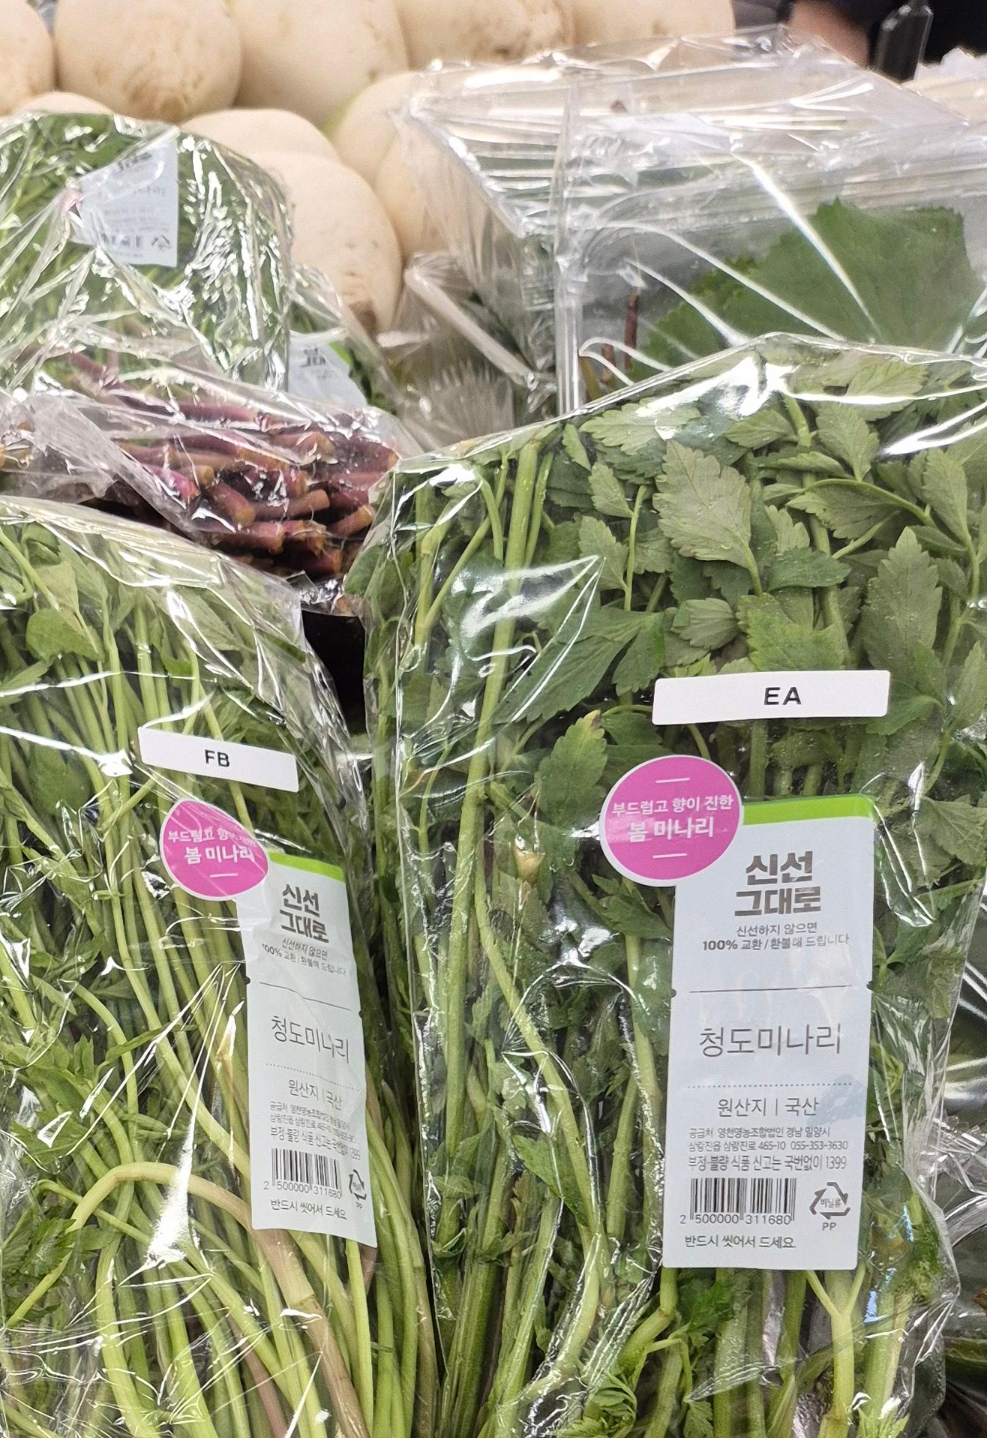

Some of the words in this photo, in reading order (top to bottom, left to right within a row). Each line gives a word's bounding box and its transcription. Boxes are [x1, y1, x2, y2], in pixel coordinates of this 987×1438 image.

[764, 687, 801, 705] EA
[204, 749, 231, 768] FB
[611, 799, 669, 817] 부드럽고
[672, 797, 700, 812] 향이
[704, 795, 733, 811] 진한
[628, 821, 648, 842] 봄
[653, 817, 714, 840] 미나리
[184, 847, 202, 865] 봄
[205, 845, 254, 864] 미나리
[746, 851, 813, 885] 신선
[282, 884, 320, 917] 신선
[734, 886, 821, 916] 그대로
[280, 910, 329, 943] 그대로
[736, 924, 780, 937] 신선하지
[784, 922, 817, 935] 않으면
[282, 938, 309, 954] 신선하지
[703, 939, 738, 951] 100%
[806, 934, 849, 948] 드립니다
[699, 1023, 841, 1057] 청도미나리
[288, 1079, 319, 1102] 원산지
[326, 1090, 342, 1111] 국산
[718, 1097, 766, 1117] 원산지
[785, 1097, 819, 1116] 국산
[786, 1127, 803, 1138] 경남
[758, 1141, 786, 1151] 465-10
[790, 1140, 849, 1150] 055-353-3630
[731, 1155, 750, 1171] 식품
[753, 1156, 782, 1171] 신고는
[784, 1155, 823, 1171] 국번없이
[825, 1156, 847, 1170] 1399
[263, 1181, 270, 1191] 2
[277, 1181, 310, 1194] 500000
[270, 1199, 298, 1212] 반드시
[300, 1201, 324, 1217] 씻어서
[325, 1206, 348, 1221] 드세요
[680, 1215, 686, 1224] 2
[695, 1214, 739, 1224] 500000
[745, 1215, 791, 1225] 311680
[822, 1222, 837, 1231] PP
[685, 1235, 719, 1247] 반드시
[723, 1235, 756, 1248] 씻어서
[760, 1236, 796, 1249] 드세요
